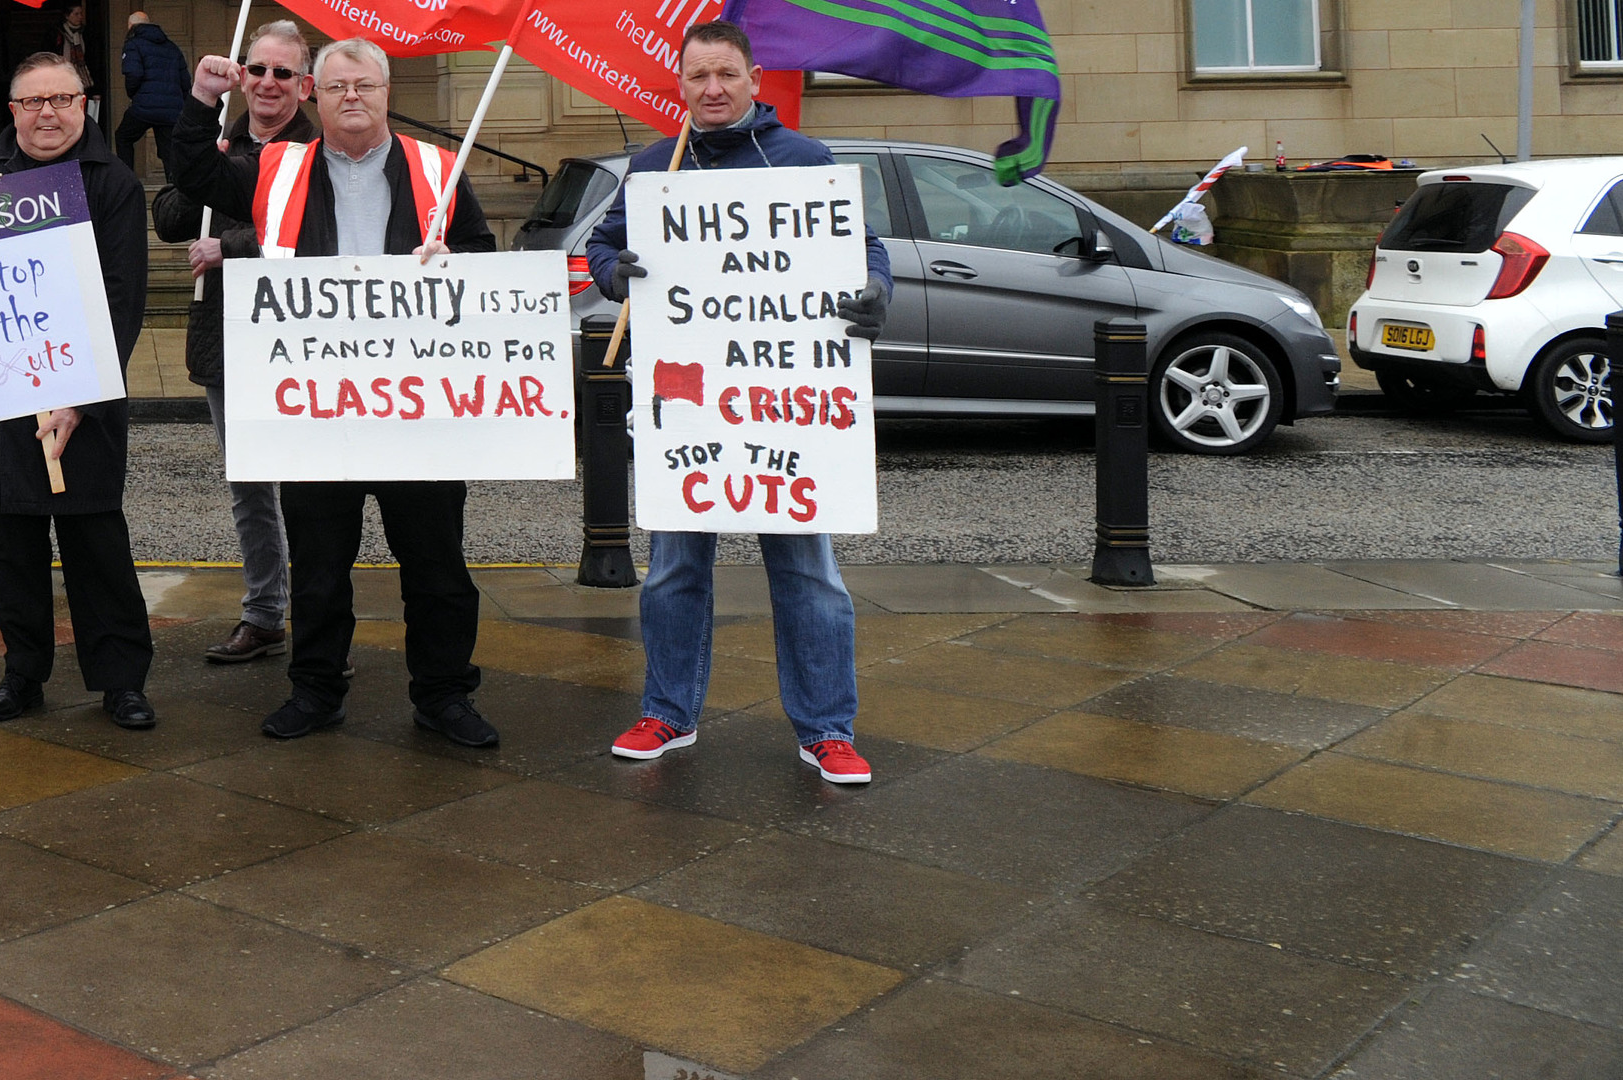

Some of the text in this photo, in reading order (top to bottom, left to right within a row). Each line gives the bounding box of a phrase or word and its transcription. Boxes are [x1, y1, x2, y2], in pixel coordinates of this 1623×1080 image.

[663, 200, 852, 242] NHS FIFE
[721, 250, 791, 274] AND
[251, 275, 562, 326] AUSTERITY IS JUST
[269, 336, 555, 364] A FANCY WORD FOR
[725, 339, 852, 369] ARE IN
[1386, 327, 1430, 345] SO16 LGJ
[275, 374, 570, 420] CLASS WAR.
[718, 385, 857, 431] CRISIS
[664, 441, 800, 477] STOP THE
[682, 471, 818, 523] CUTS
